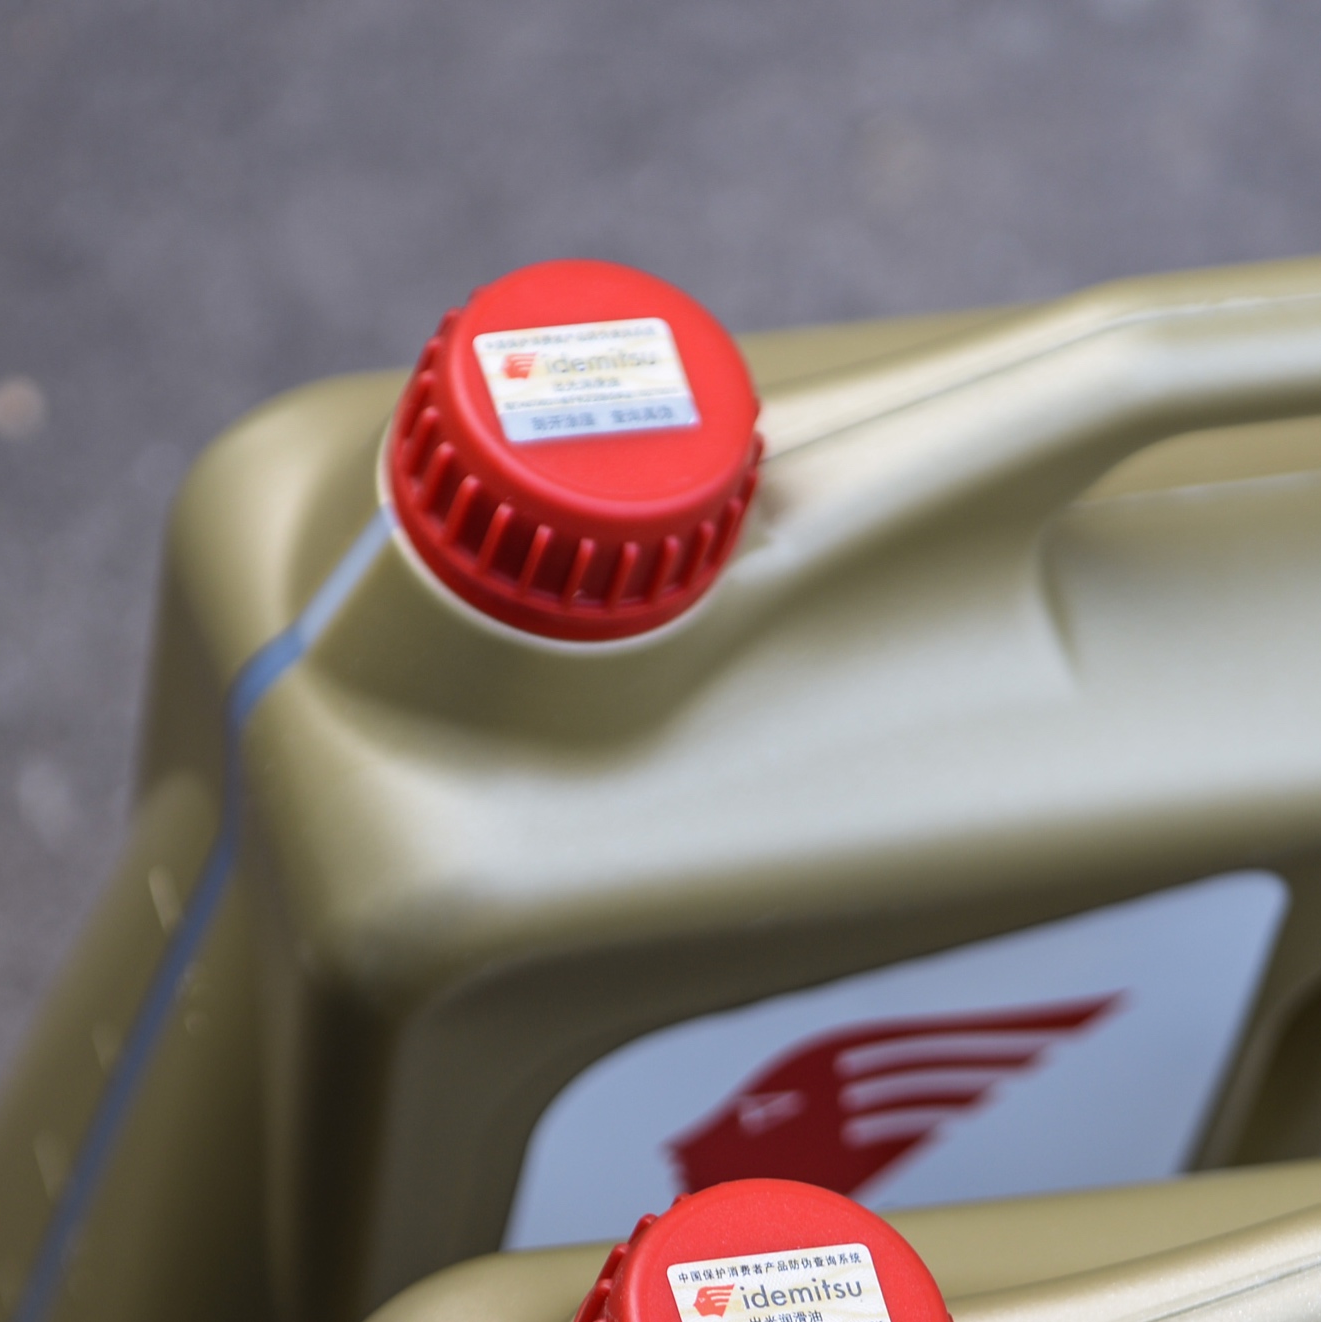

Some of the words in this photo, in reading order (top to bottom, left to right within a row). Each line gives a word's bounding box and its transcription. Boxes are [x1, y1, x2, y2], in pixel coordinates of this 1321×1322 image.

[543, 348, 657, 374] idemitsu
[678, 1252, 862, 1283] 中国保护消费者产品防伪查询系统
[739, 1277, 862, 1310] idemitsu
